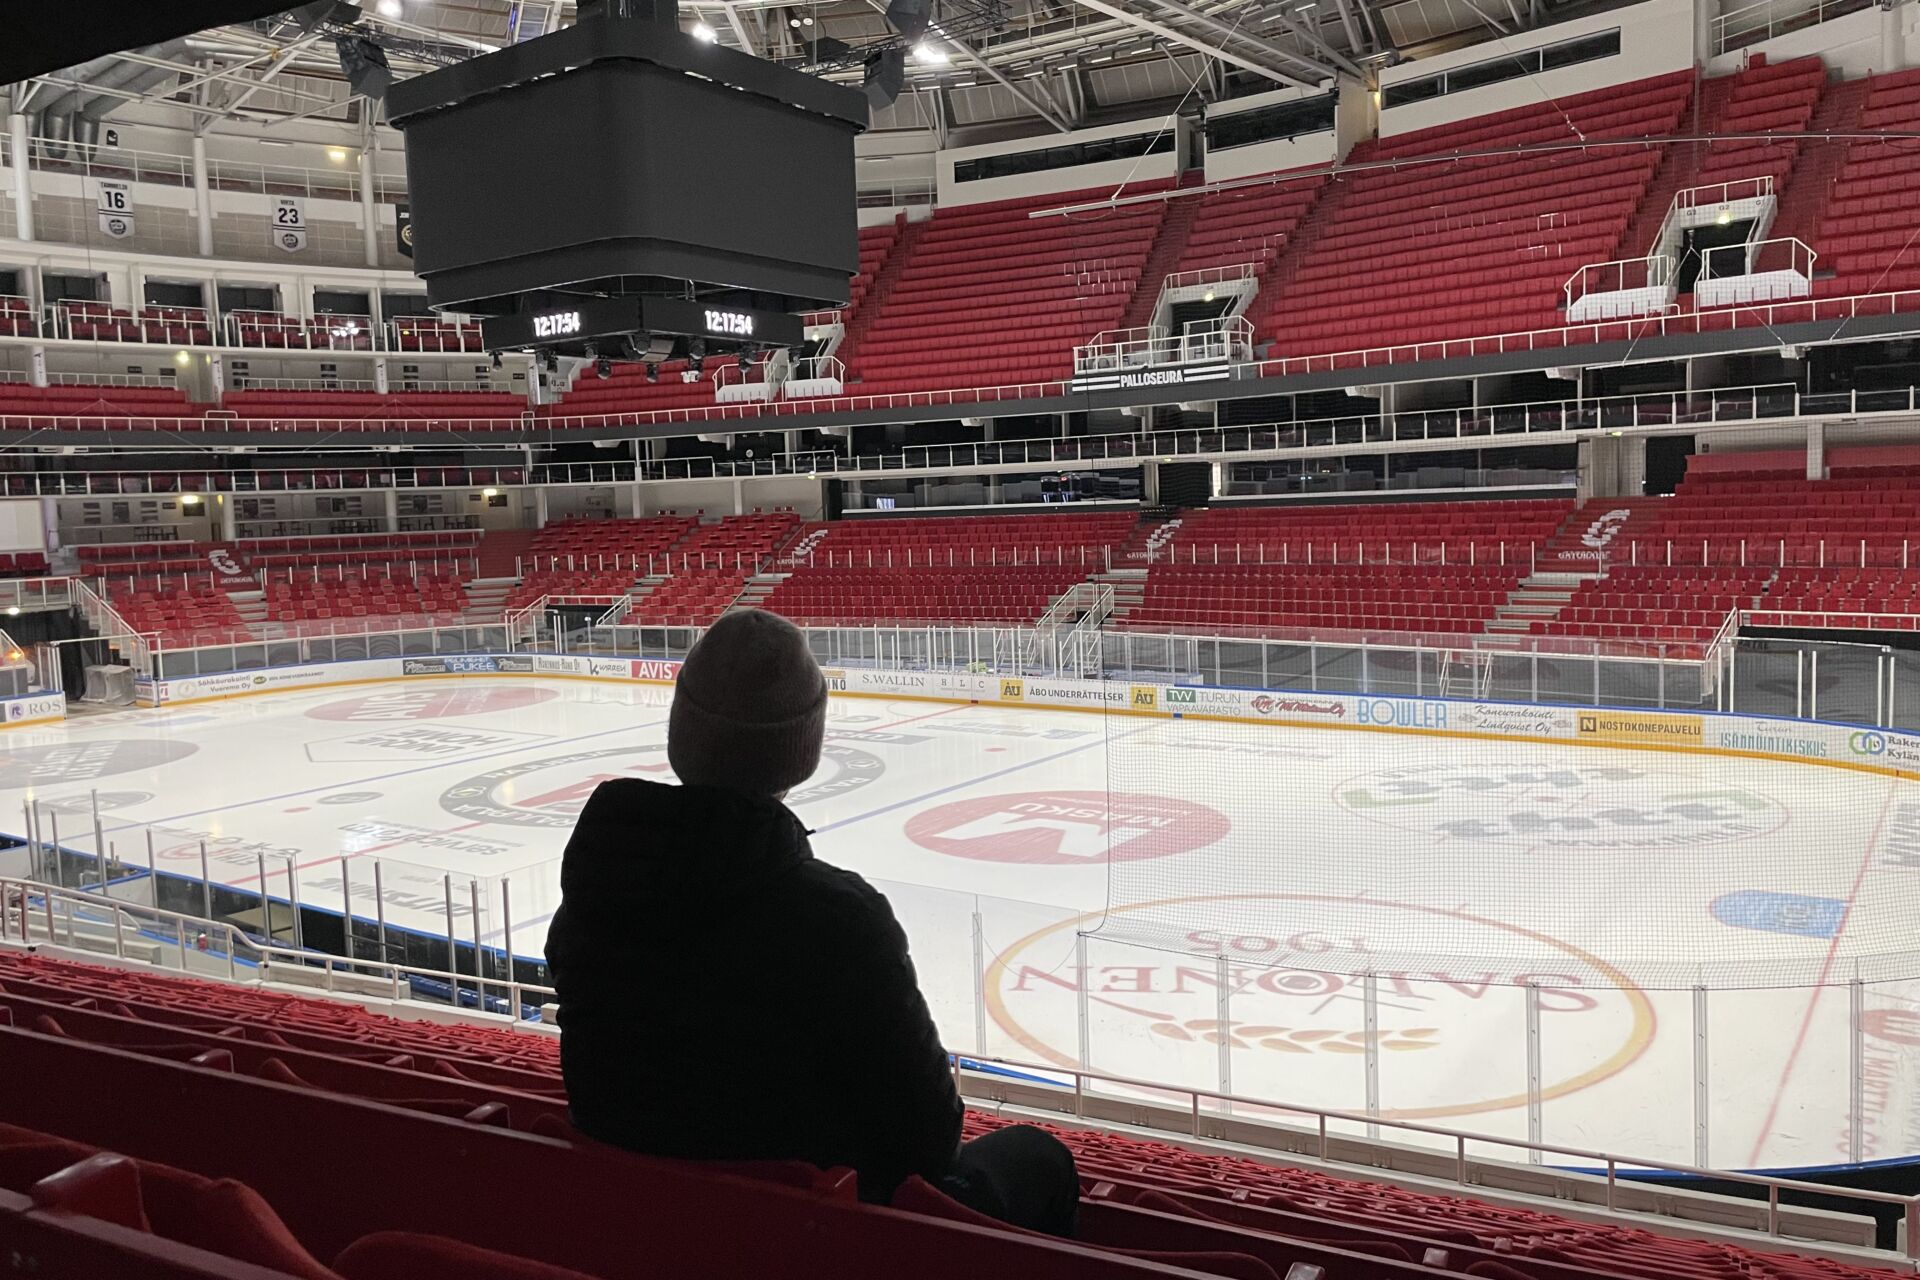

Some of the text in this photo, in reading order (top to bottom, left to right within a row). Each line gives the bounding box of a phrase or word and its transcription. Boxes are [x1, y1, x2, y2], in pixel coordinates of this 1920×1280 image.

[105, 191, 125, 209] 16
[278, 207, 299, 224] 23
[534, 311, 580, 337] 12:17:54
[704, 310, 752, 335] 12:17:54
[1120, 369, 1184, 388] PALLOSEURA
[638, 662, 673, 679] AVIS
[828, 679, 846, 691] INO
[862, 674, 926, 688] S.WALLIN
[1029, 686, 1124, 701] ÅBO UNDERRÄTTELSER
[1200, 692, 1241, 704] TURUN
[1167, 703, 1241, 716] VAPAAVARASTO
[1357, 699, 1447, 729] BOWLER
[1600, 720, 1701, 736] NOSTOKONEPALVELU
[1009, 802, 1177, 829] MASKU
[1185, 929, 1370, 956] 1905
